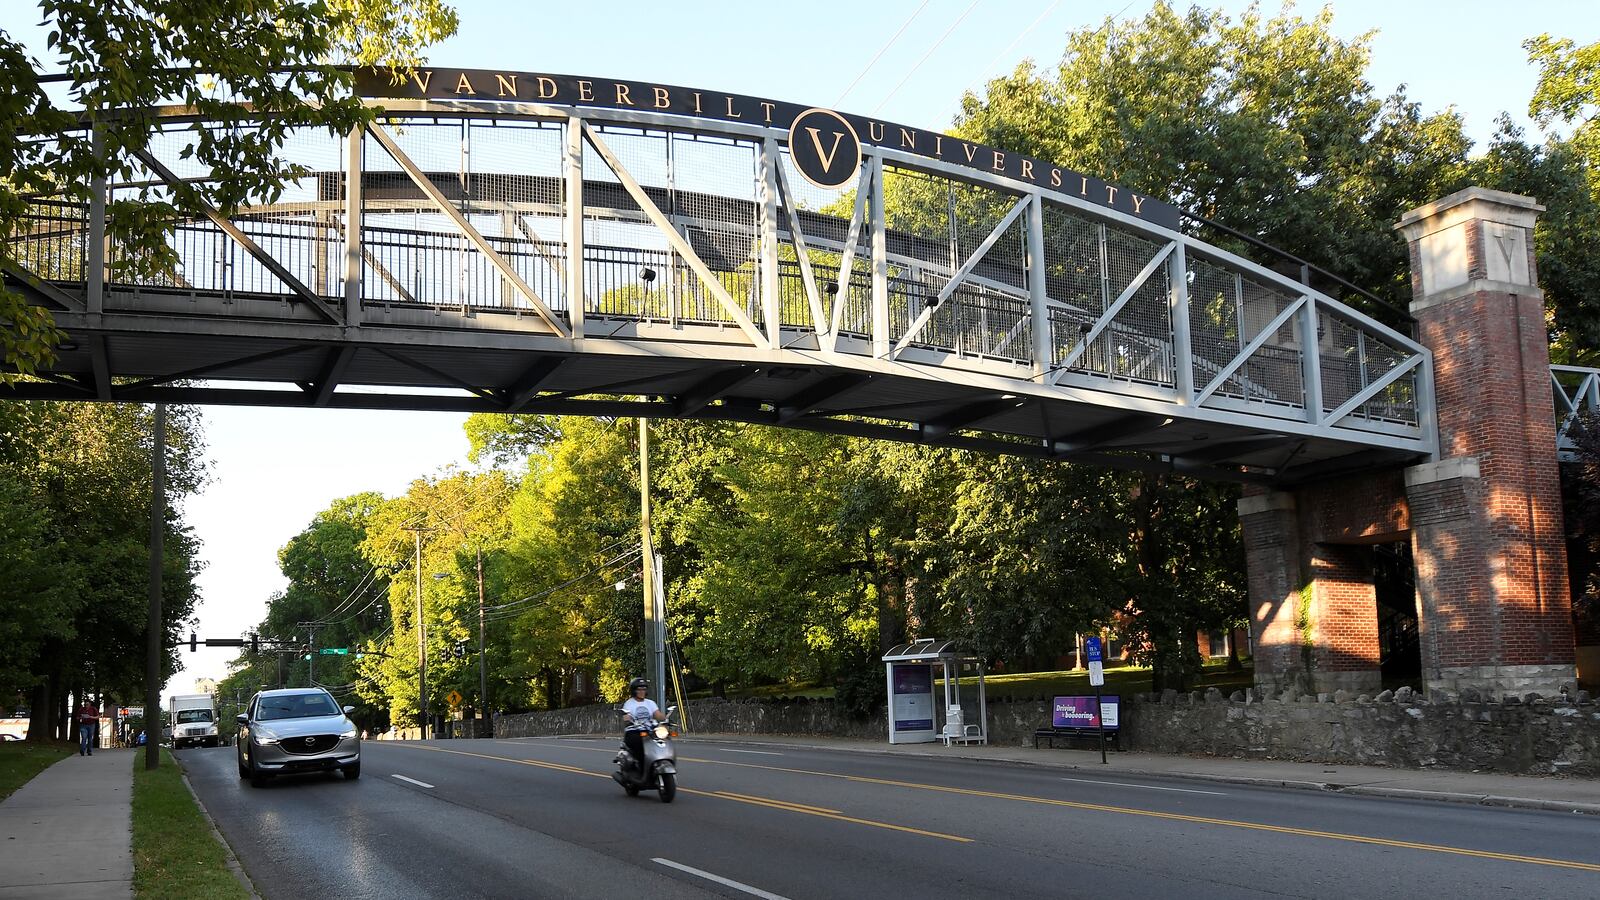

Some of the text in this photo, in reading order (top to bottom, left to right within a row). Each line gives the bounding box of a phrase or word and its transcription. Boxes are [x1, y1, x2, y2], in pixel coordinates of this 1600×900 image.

[414, 71, 776, 122] VANDERBILT
[805, 127, 845, 174] V
[868, 121, 1146, 214] UNIVERSITY
[1056, 704, 1076, 713] Driving
